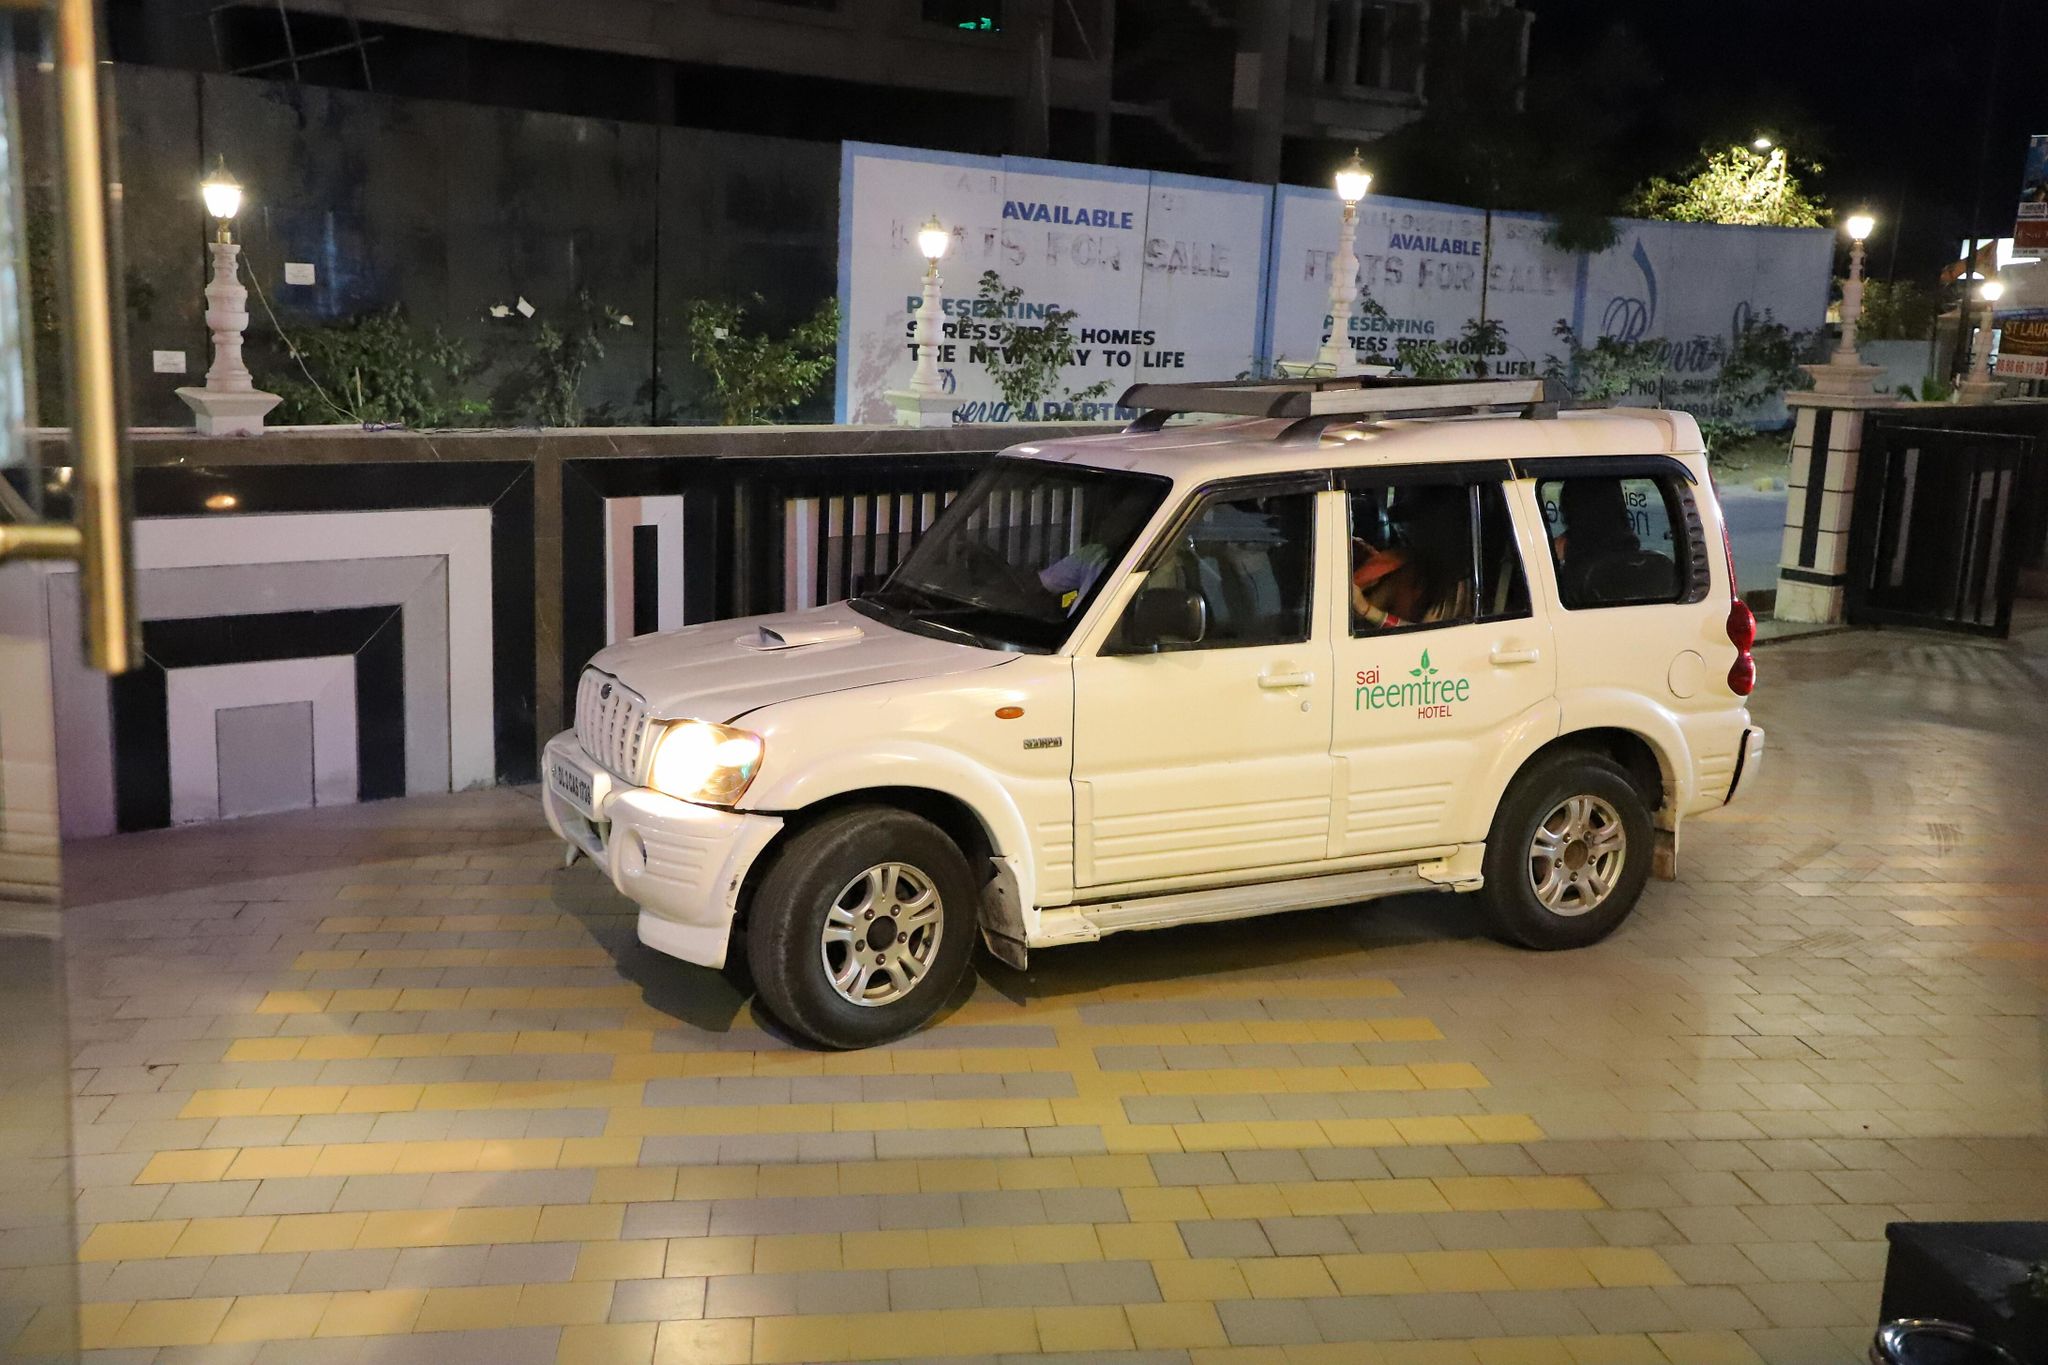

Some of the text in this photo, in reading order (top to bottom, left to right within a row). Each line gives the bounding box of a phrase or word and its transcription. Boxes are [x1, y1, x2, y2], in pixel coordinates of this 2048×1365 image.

[1002, 200, 1133, 230] AVAILABLE
[1390, 233, 1482, 257] AVAILABLE
[906, 296, 1061, 319] PESETING
[906, 320, 1001, 341] SRESS
[1081, 328, 1156, 346] HOMES
[1323, 315, 1435, 335] PESENTING
[907, 343, 956, 363] TE
[1103, 350, 1132, 368] TO
[1143, 351, 1185, 369] LIFE
[1356, 665, 1379, 685] sai
[1356, 675, 1470, 711] neemtree
[1418, 705, 1452, 719] HOTEL
